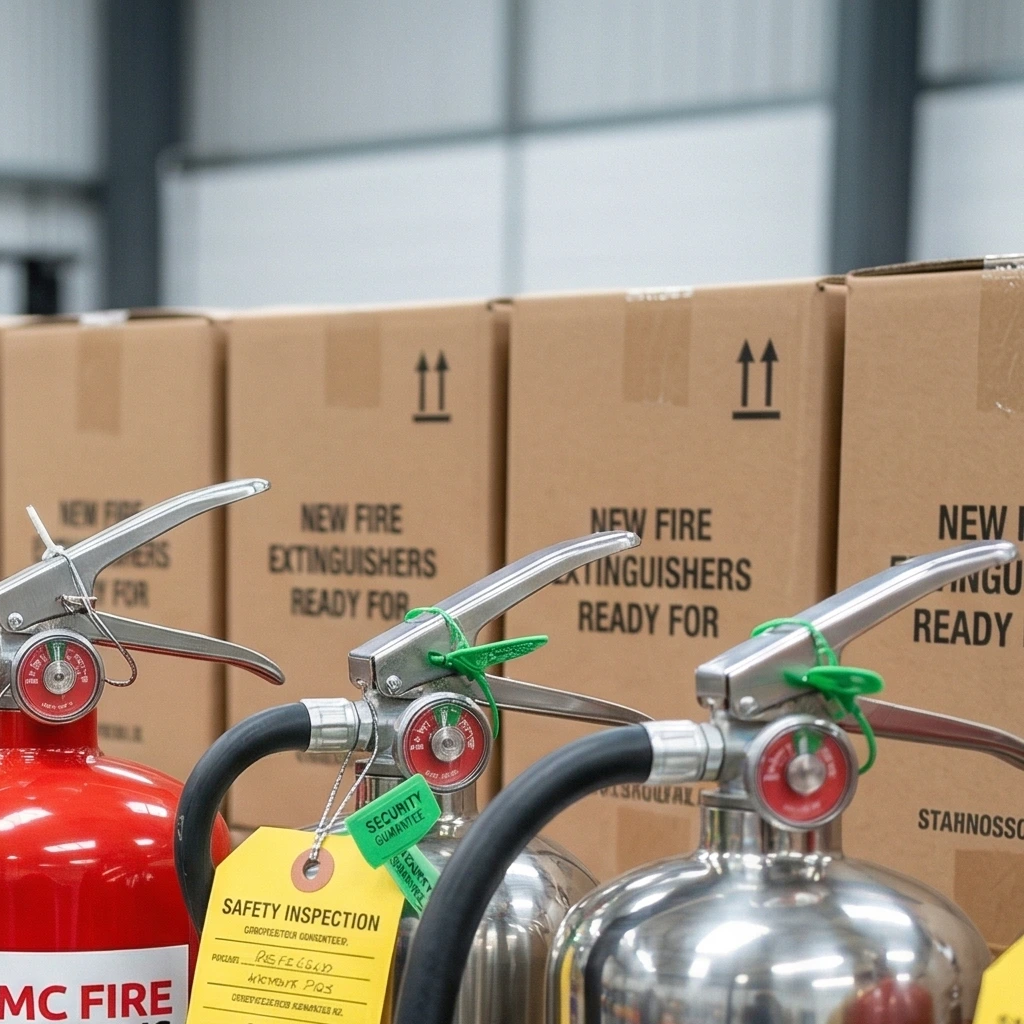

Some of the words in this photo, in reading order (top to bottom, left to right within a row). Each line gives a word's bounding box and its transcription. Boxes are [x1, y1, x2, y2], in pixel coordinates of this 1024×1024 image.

[300, 503, 349, 532] NEW
[355, 503, 402, 534] FIRE
[655, 508, 713, 541] FIRE
[938, 504, 1008, 541] NEW
[269, 544, 437, 579] EXTINGUISHERS
[290, 587, 362, 619] READY
[577, 600, 660, 635] READY
[669, 604, 719, 638] FOR
[912, 607, 1014, 648] READY
[365, 790, 423, 834] SECURITY
[221, 897, 282, 920] SAFETY
[284, 904, 381, 932] INSPECTION
[80, 979, 174, 1020] FIRE
